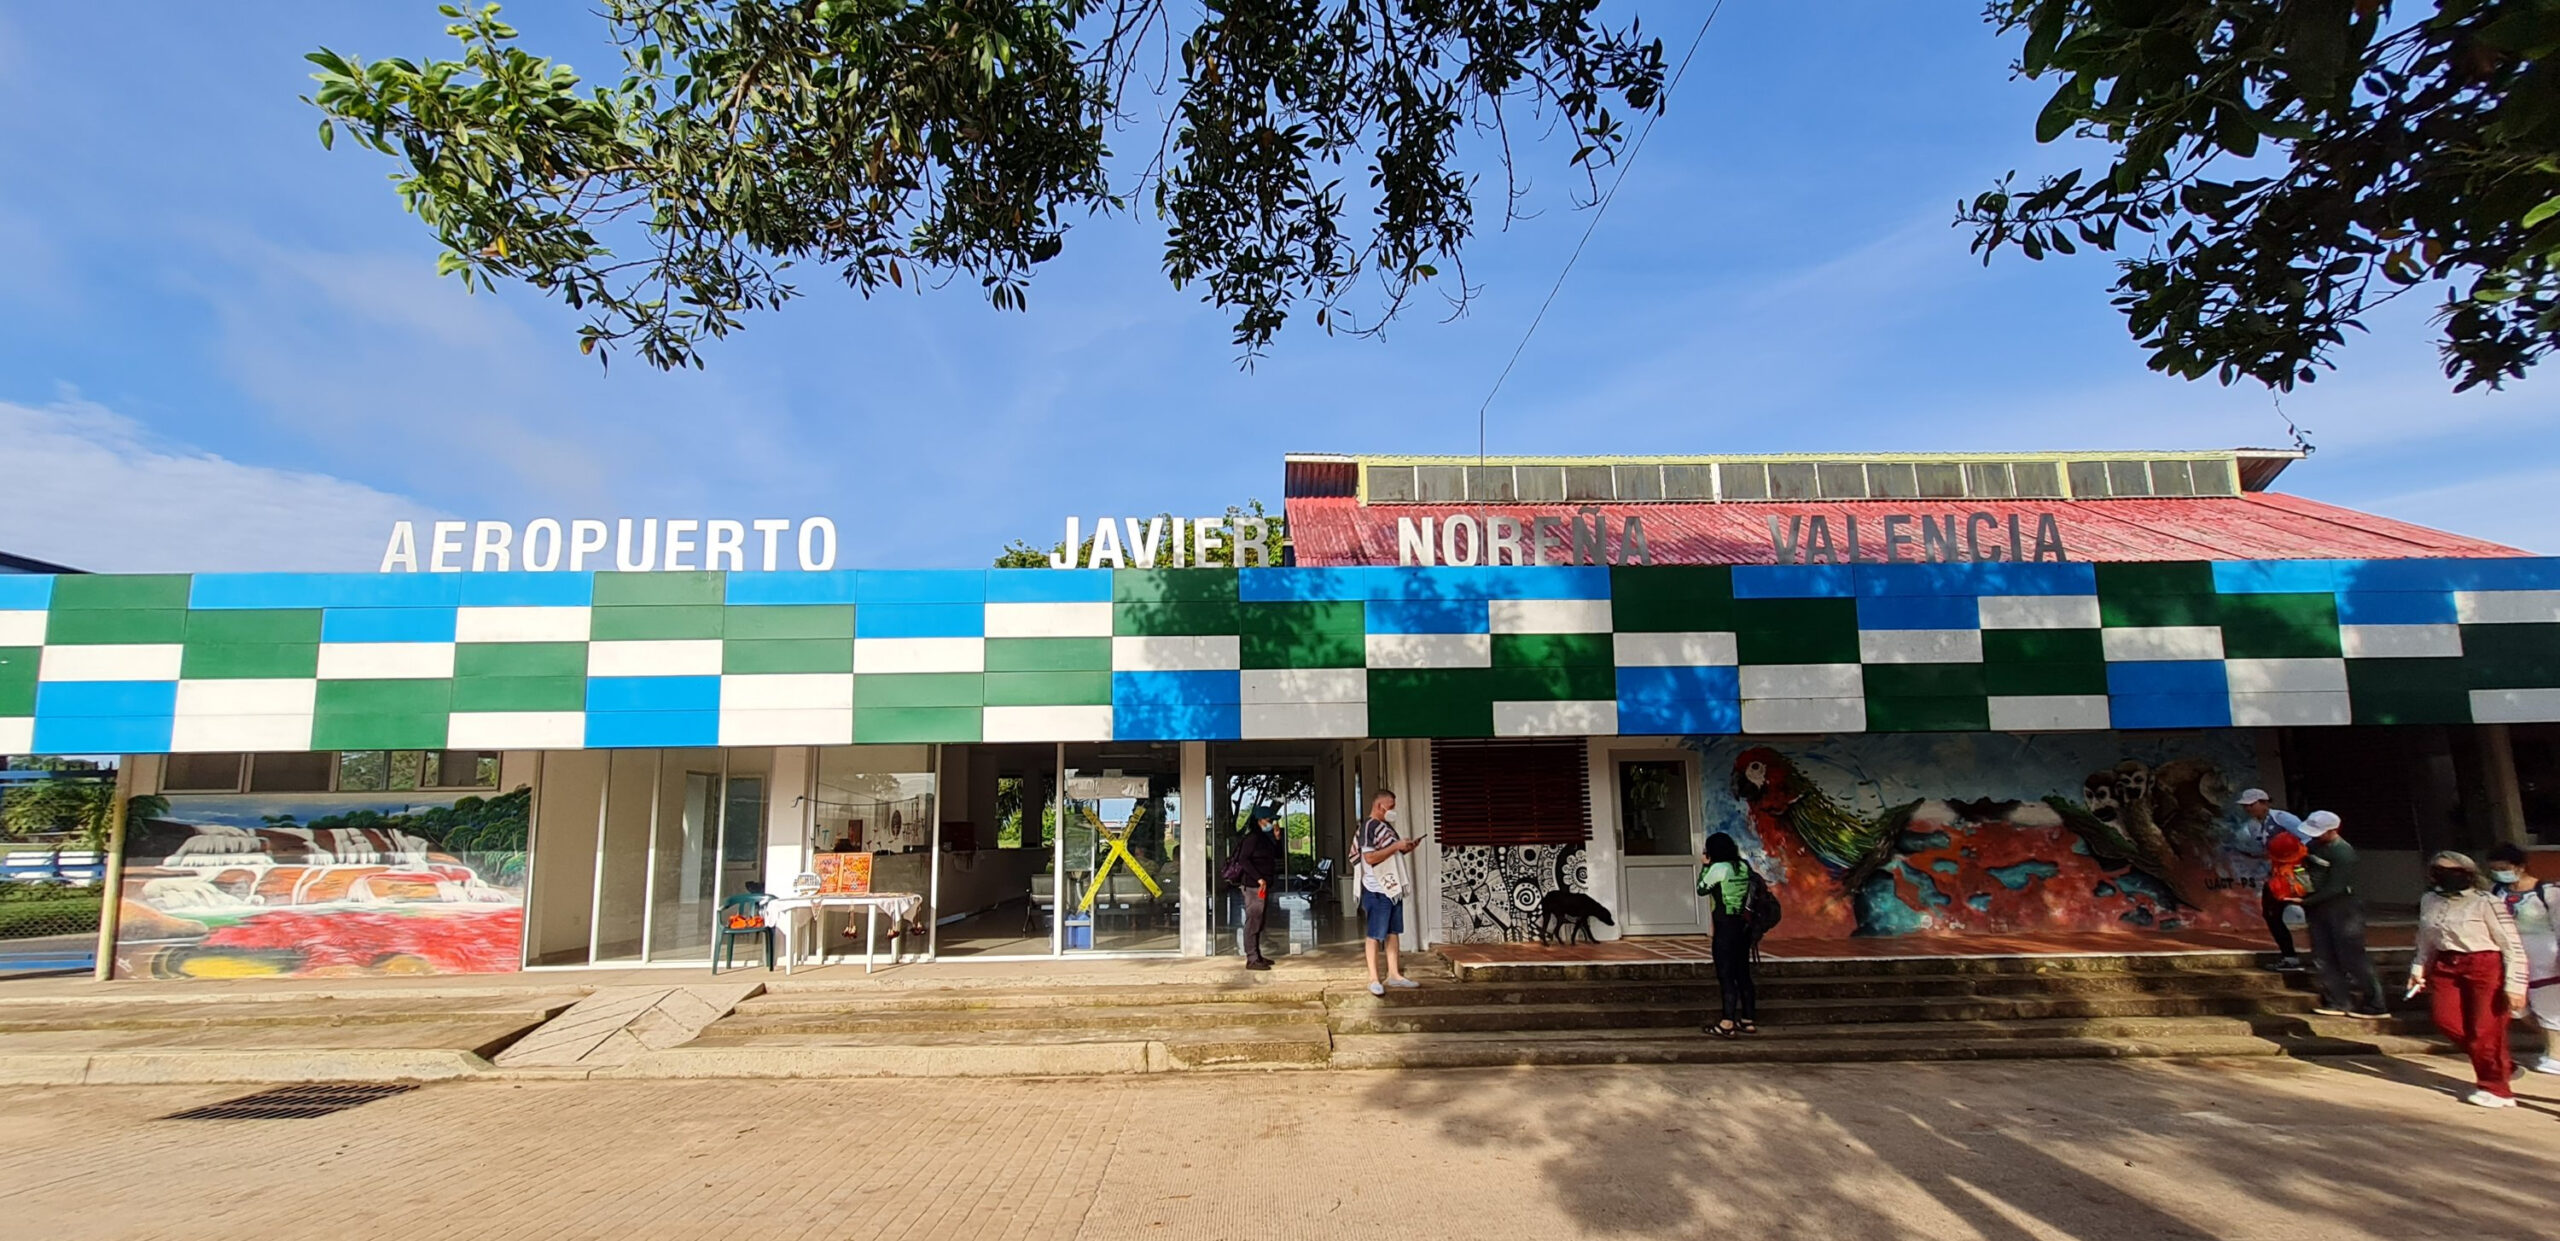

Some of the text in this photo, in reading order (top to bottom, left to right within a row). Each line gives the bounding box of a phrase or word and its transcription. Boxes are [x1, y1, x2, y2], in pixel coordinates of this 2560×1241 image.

[379, 507, 2067, 573] AEROPUERTO JAVIER NOREÑA VALENCIA
